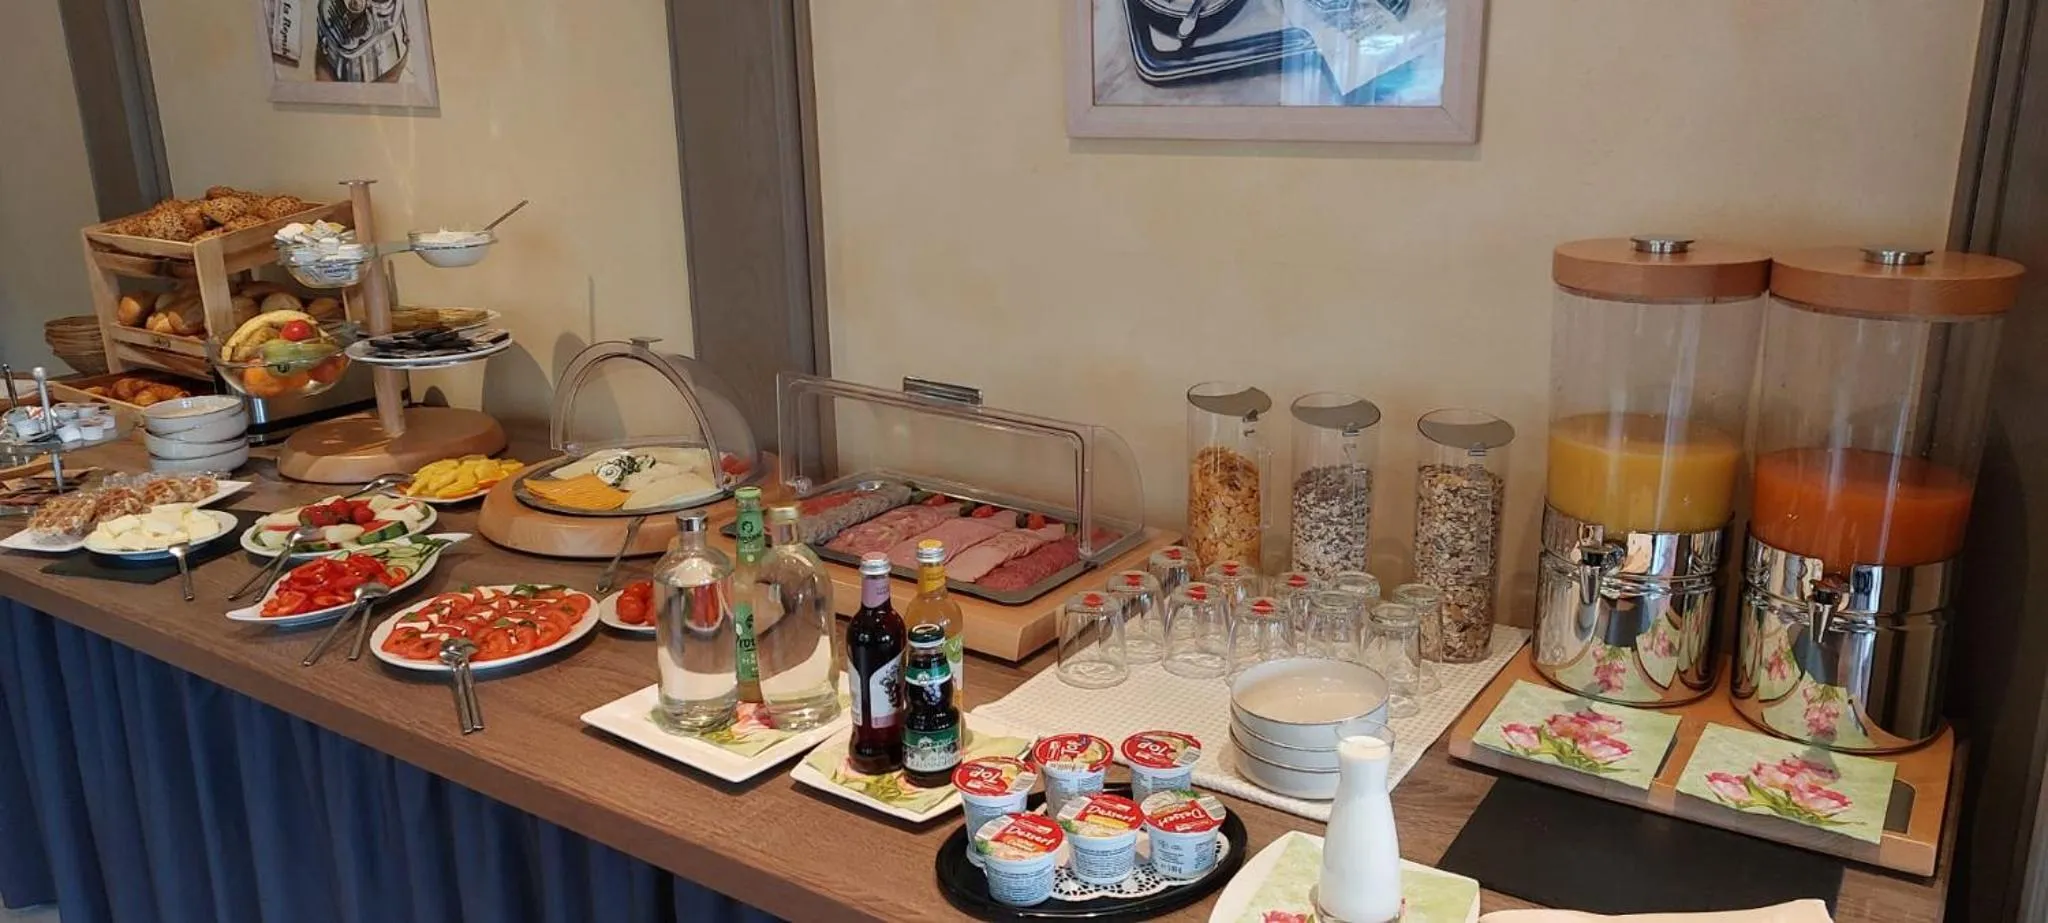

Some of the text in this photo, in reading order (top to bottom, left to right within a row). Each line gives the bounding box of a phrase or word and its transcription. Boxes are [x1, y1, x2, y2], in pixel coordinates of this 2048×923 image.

[1136, 741, 1168, 757] Top
[968, 768, 1001, 784] Top
[1086, 804, 1137, 823] Dessert
[1157, 808, 1206, 828] Dessert
[1004, 825, 1057, 846] Dessert
